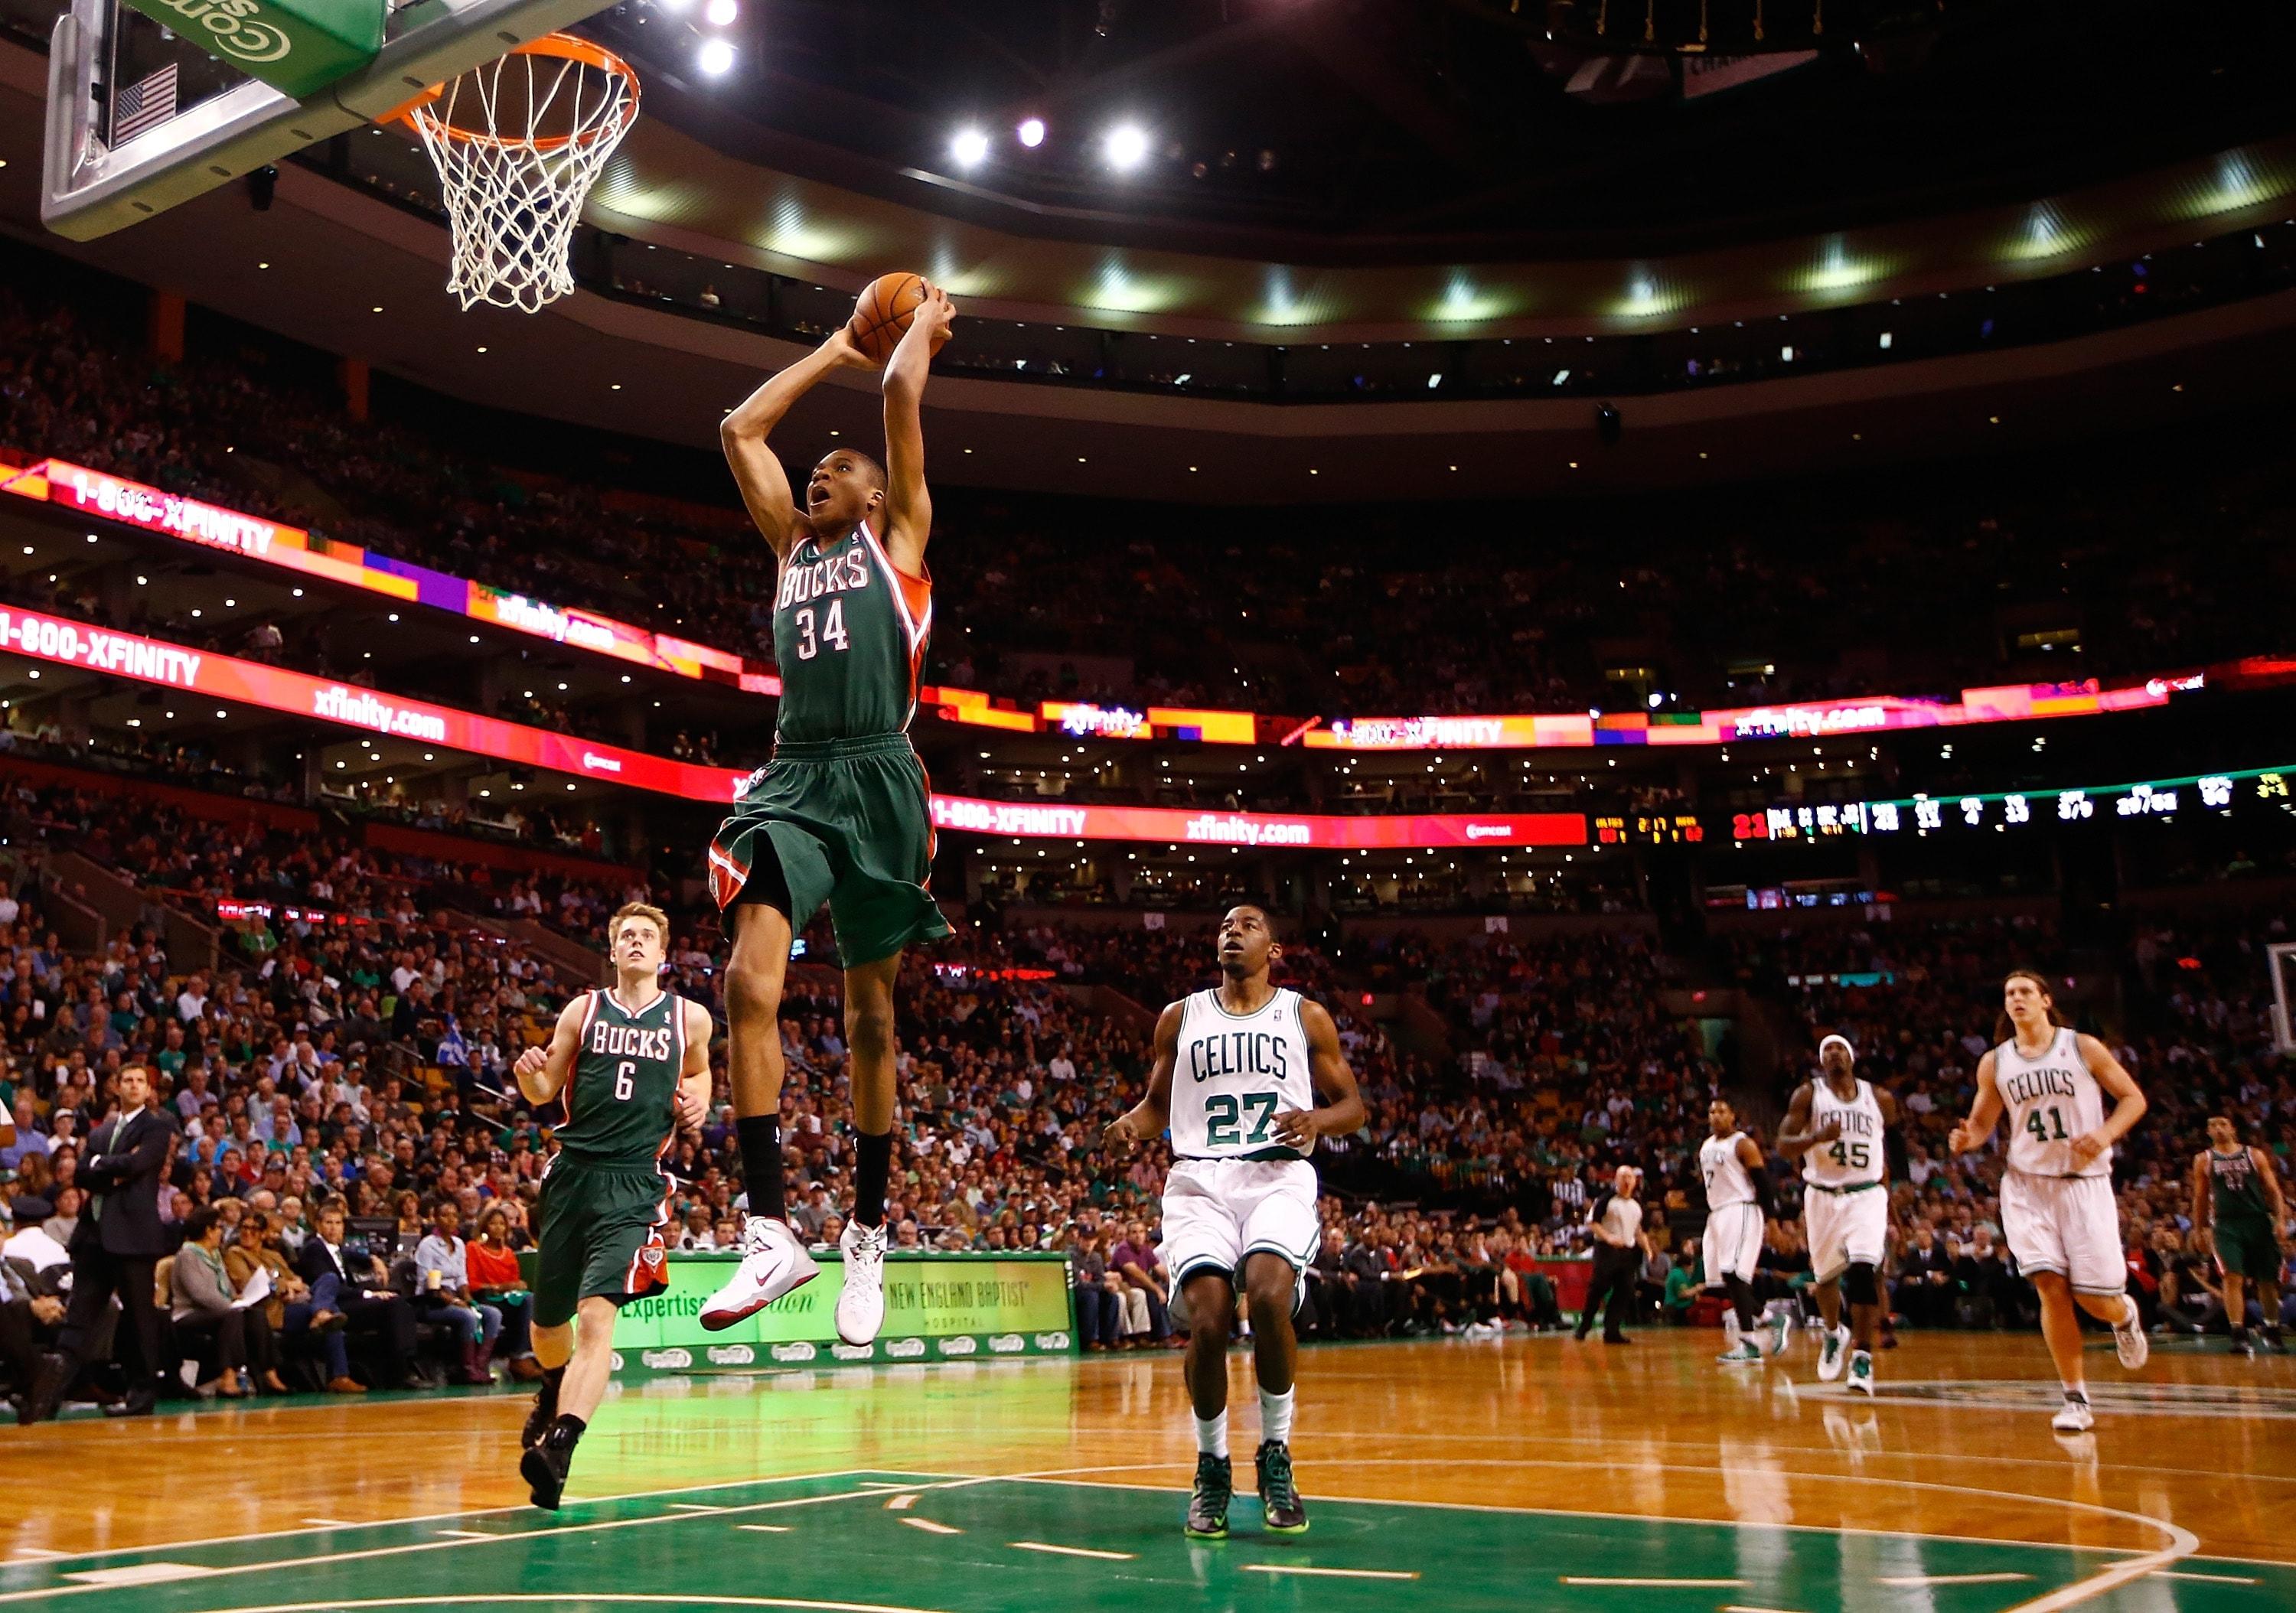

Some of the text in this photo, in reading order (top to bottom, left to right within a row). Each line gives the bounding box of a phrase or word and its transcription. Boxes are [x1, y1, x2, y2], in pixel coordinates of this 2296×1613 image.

[779, 547, 869, 610] BUCKS
[795, 598, 850, 660] 34
[0, 612, 201, 686] 1-800-XFINITY
[313, 686, 445, 741] xfinity.com
[934, 800, 1086, 835] 1-800-XFINITY
[1186, 816, 1310, 846] xfinity.com
[592, 1021, 671, 1061] BUCKS
[1190, 1032, 1287, 1083] CELTICS
[615, 1061, 636, 1100] 6
[2007, 1068, 2076, 1106] CELTICS
[1205, 1092, 1278, 1147] 27
[2028, 1106, 2068, 1142] 41
[1828, 1141, 1870, 1168] 45
[889, 1282, 916, 1309] NEW
[919, 1281, 974, 1310] ENGLAND
